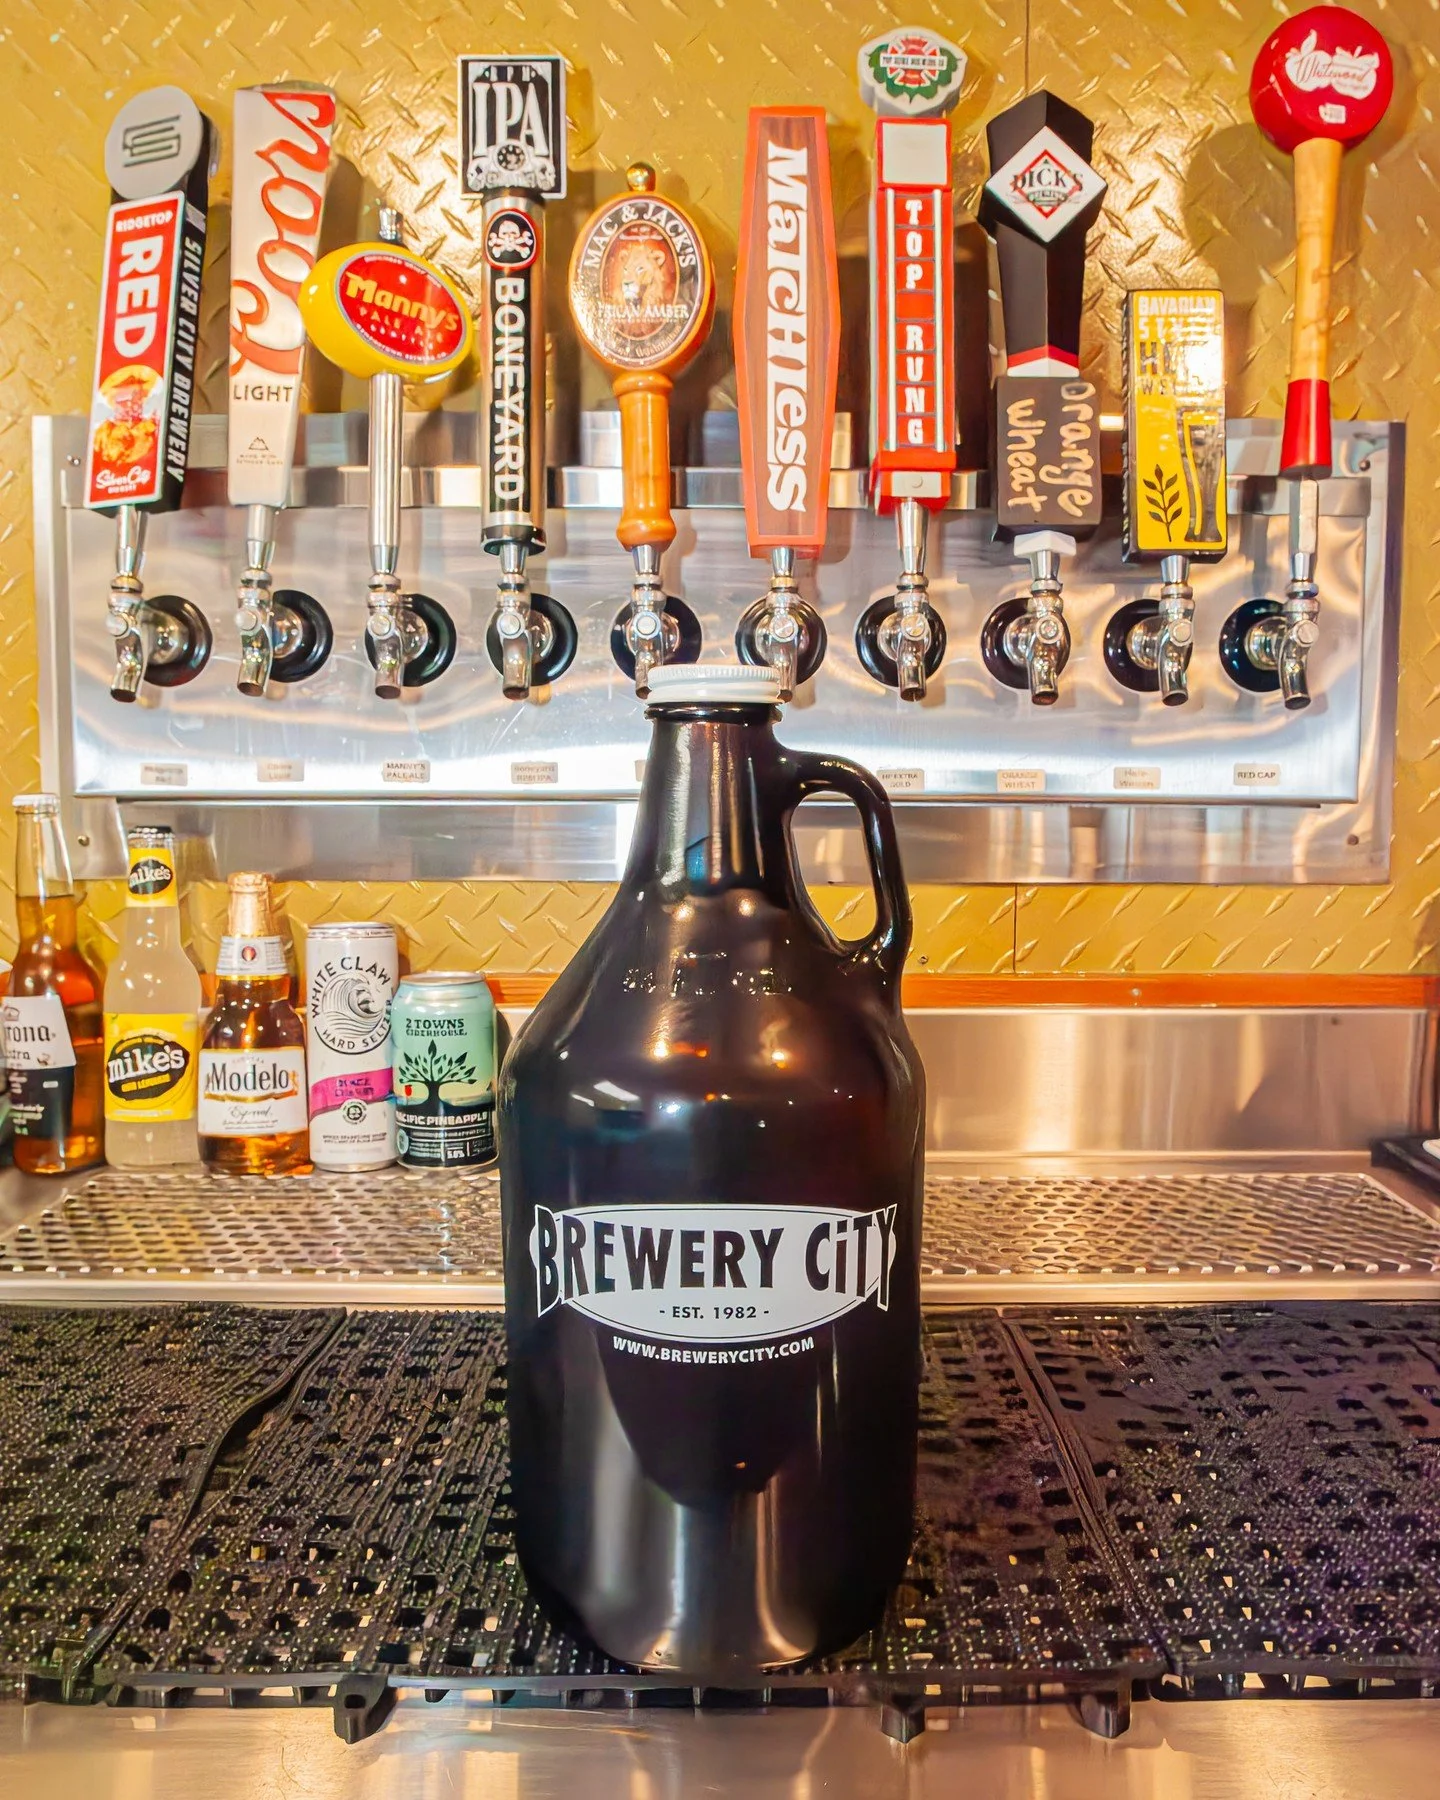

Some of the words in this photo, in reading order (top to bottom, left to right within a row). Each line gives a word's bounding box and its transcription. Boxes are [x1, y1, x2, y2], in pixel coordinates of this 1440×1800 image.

[472, 82, 549, 156] IPA
[115, 209, 174, 233] RIDGETOP
[583, 216, 619, 269] MAC
[621, 203, 639, 223] &
[643, 203, 696, 269] JACK'S
[904, 199, 923, 290] TOP
[180, 236, 202, 316] SILVER
[113, 235, 164, 359] RED
[644, 303, 690, 320] AMBER
[175, 316, 197, 371] CITY
[233, 384, 293, 402] LIGHT
[494, 277, 526, 501] BONEYARD
[904, 325, 925, 445] RUNG
[167, 374, 191, 483] BREWERY
[1237, 771, 1256, 779] RED
[1257, 771, 1276, 779] CAP
[128, 864, 171, 889] mike's
[311, 962, 338, 1019] WHITE
[340, 956, 391, 986] CLAW
[5, 1025, 51, 1043] rona
[322, 1029, 356, 1050] HARD
[406, 1018, 413, 1029] 2
[414, 1018, 464, 1029] TOWNS
[107, 1045, 185, 1083] mike's
[211, 1062, 289, 1092] Modelo
[427, 1111, 488, 1126] PINEAPPLE
[535, 1203, 786, 1319] BREWERY
[672, 1306, 705, 1319] EST.
[714, 1306, 757, 1319] 1982
[612, 1335, 815, 1364] WWW.BREWERYCITY.COM
